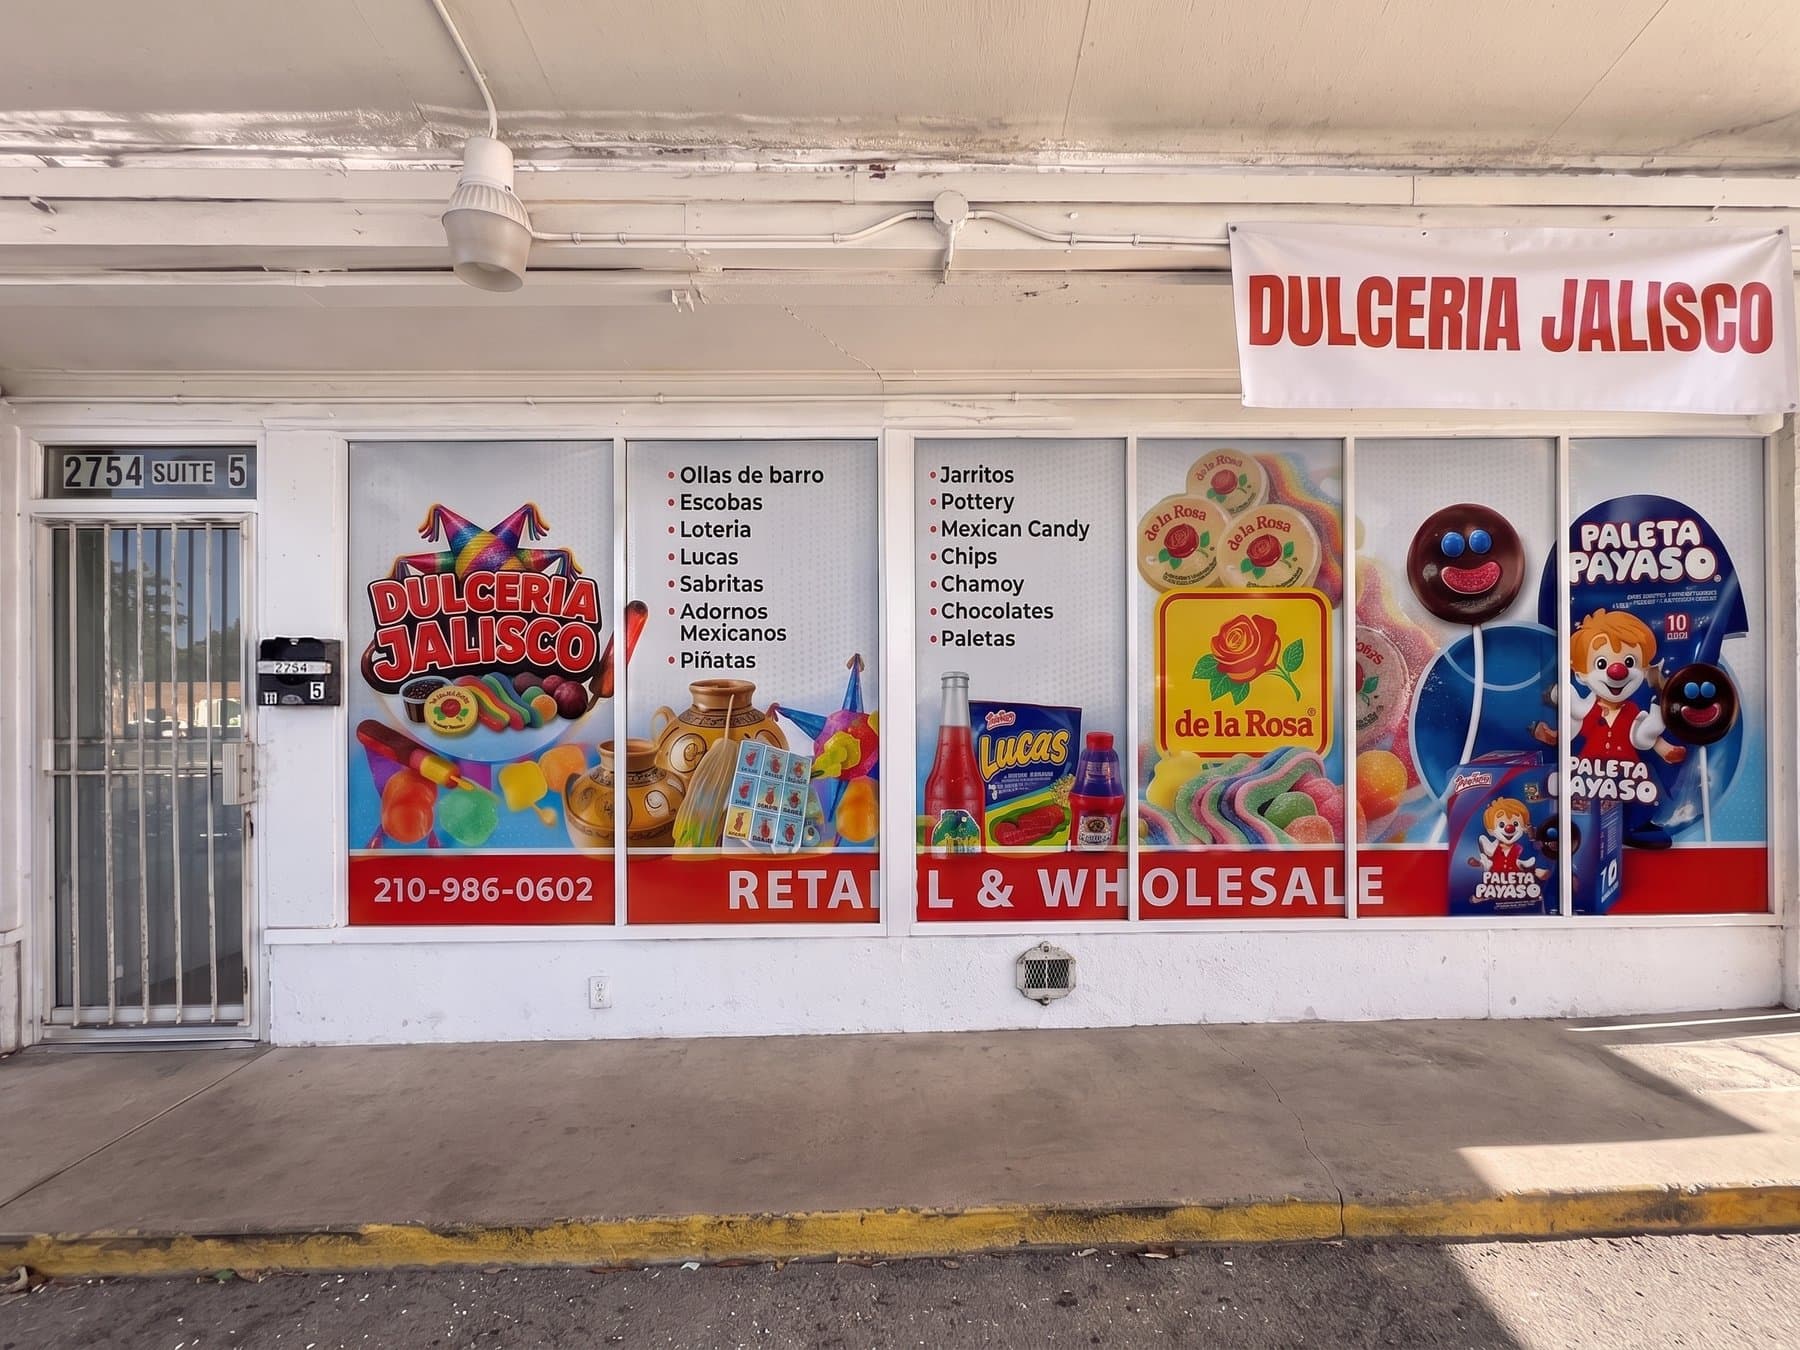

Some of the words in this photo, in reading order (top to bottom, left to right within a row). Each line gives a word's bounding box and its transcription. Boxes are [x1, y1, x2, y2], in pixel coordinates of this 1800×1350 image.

[1249, 275, 1521, 351] DULCERIA
[1541, 279, 1774, 354] JALISCO
[65, 456, 142, 487] 2754
[153, 463, 213, 482] SUITE
[229, 456, 245, 486] 5
[680, 466, 732, 484] Ollas
[738, 466, 763, 484] de
[770, 466, 824, 484] barro
[940, 465, 1014, 484] Jarritos
[680, 493, 763, 511] Escobas
[941, 493, 1015, 514] Pottery
[680, 519, 751, 538] Loteria
[941, 519, 1022, 537] Mexican
[1028, 519, 1090, 541] Candy
[1145, 524, 1160, 541] de
[1174, 505, 1207, 521] Rosa
[1227, 534, 1243, 551] de
[1239, 524, 1255, 537] la
[1256, 516, 1292, 533] Rosa
[1581, 520, 1701, 551] PALETA
[680, 548, 739, 565] Lucas
[941, 546, 997, 568] Chips
[1570, 547, 1716, 583] PAYASO
[680, 574, 764, 592] Sabritas
[941, 575, 1025, 596] Chamoy
[370, 571, 599, 625] DULCERIA
[680, 603, 768, 620] Adornos
[941, 602, 1054, 620] Chocolates
[680, 623, 787, 641] Mexicanos
[1667, 614, 1687, 632] 10
[373, 616, 597, 682] JALISCO
[941, 630, 1016, 647] Paletas
[275, 662, 307, 673] 2754
[681, 651, 756, 669] Piñatas
[313, 683, 322, 699] 5
[1175, 709, 1209, 737] de
[1214, 711, 1241, 737] la
[1246, 710, 1314, 737] Rosa
[979, 730, 1070, 782] Lucas
[1570, 756, 1648, 779] PALETA
[977, 868, 1014, 908] &
[1037, 866, 1383, 907] WHOLESALE
[1483, 871, 1535, 884] PALETA
[374, 877, 593, 903] 210-986-0602
[1475, 884, 1541, 899] PAYASO
